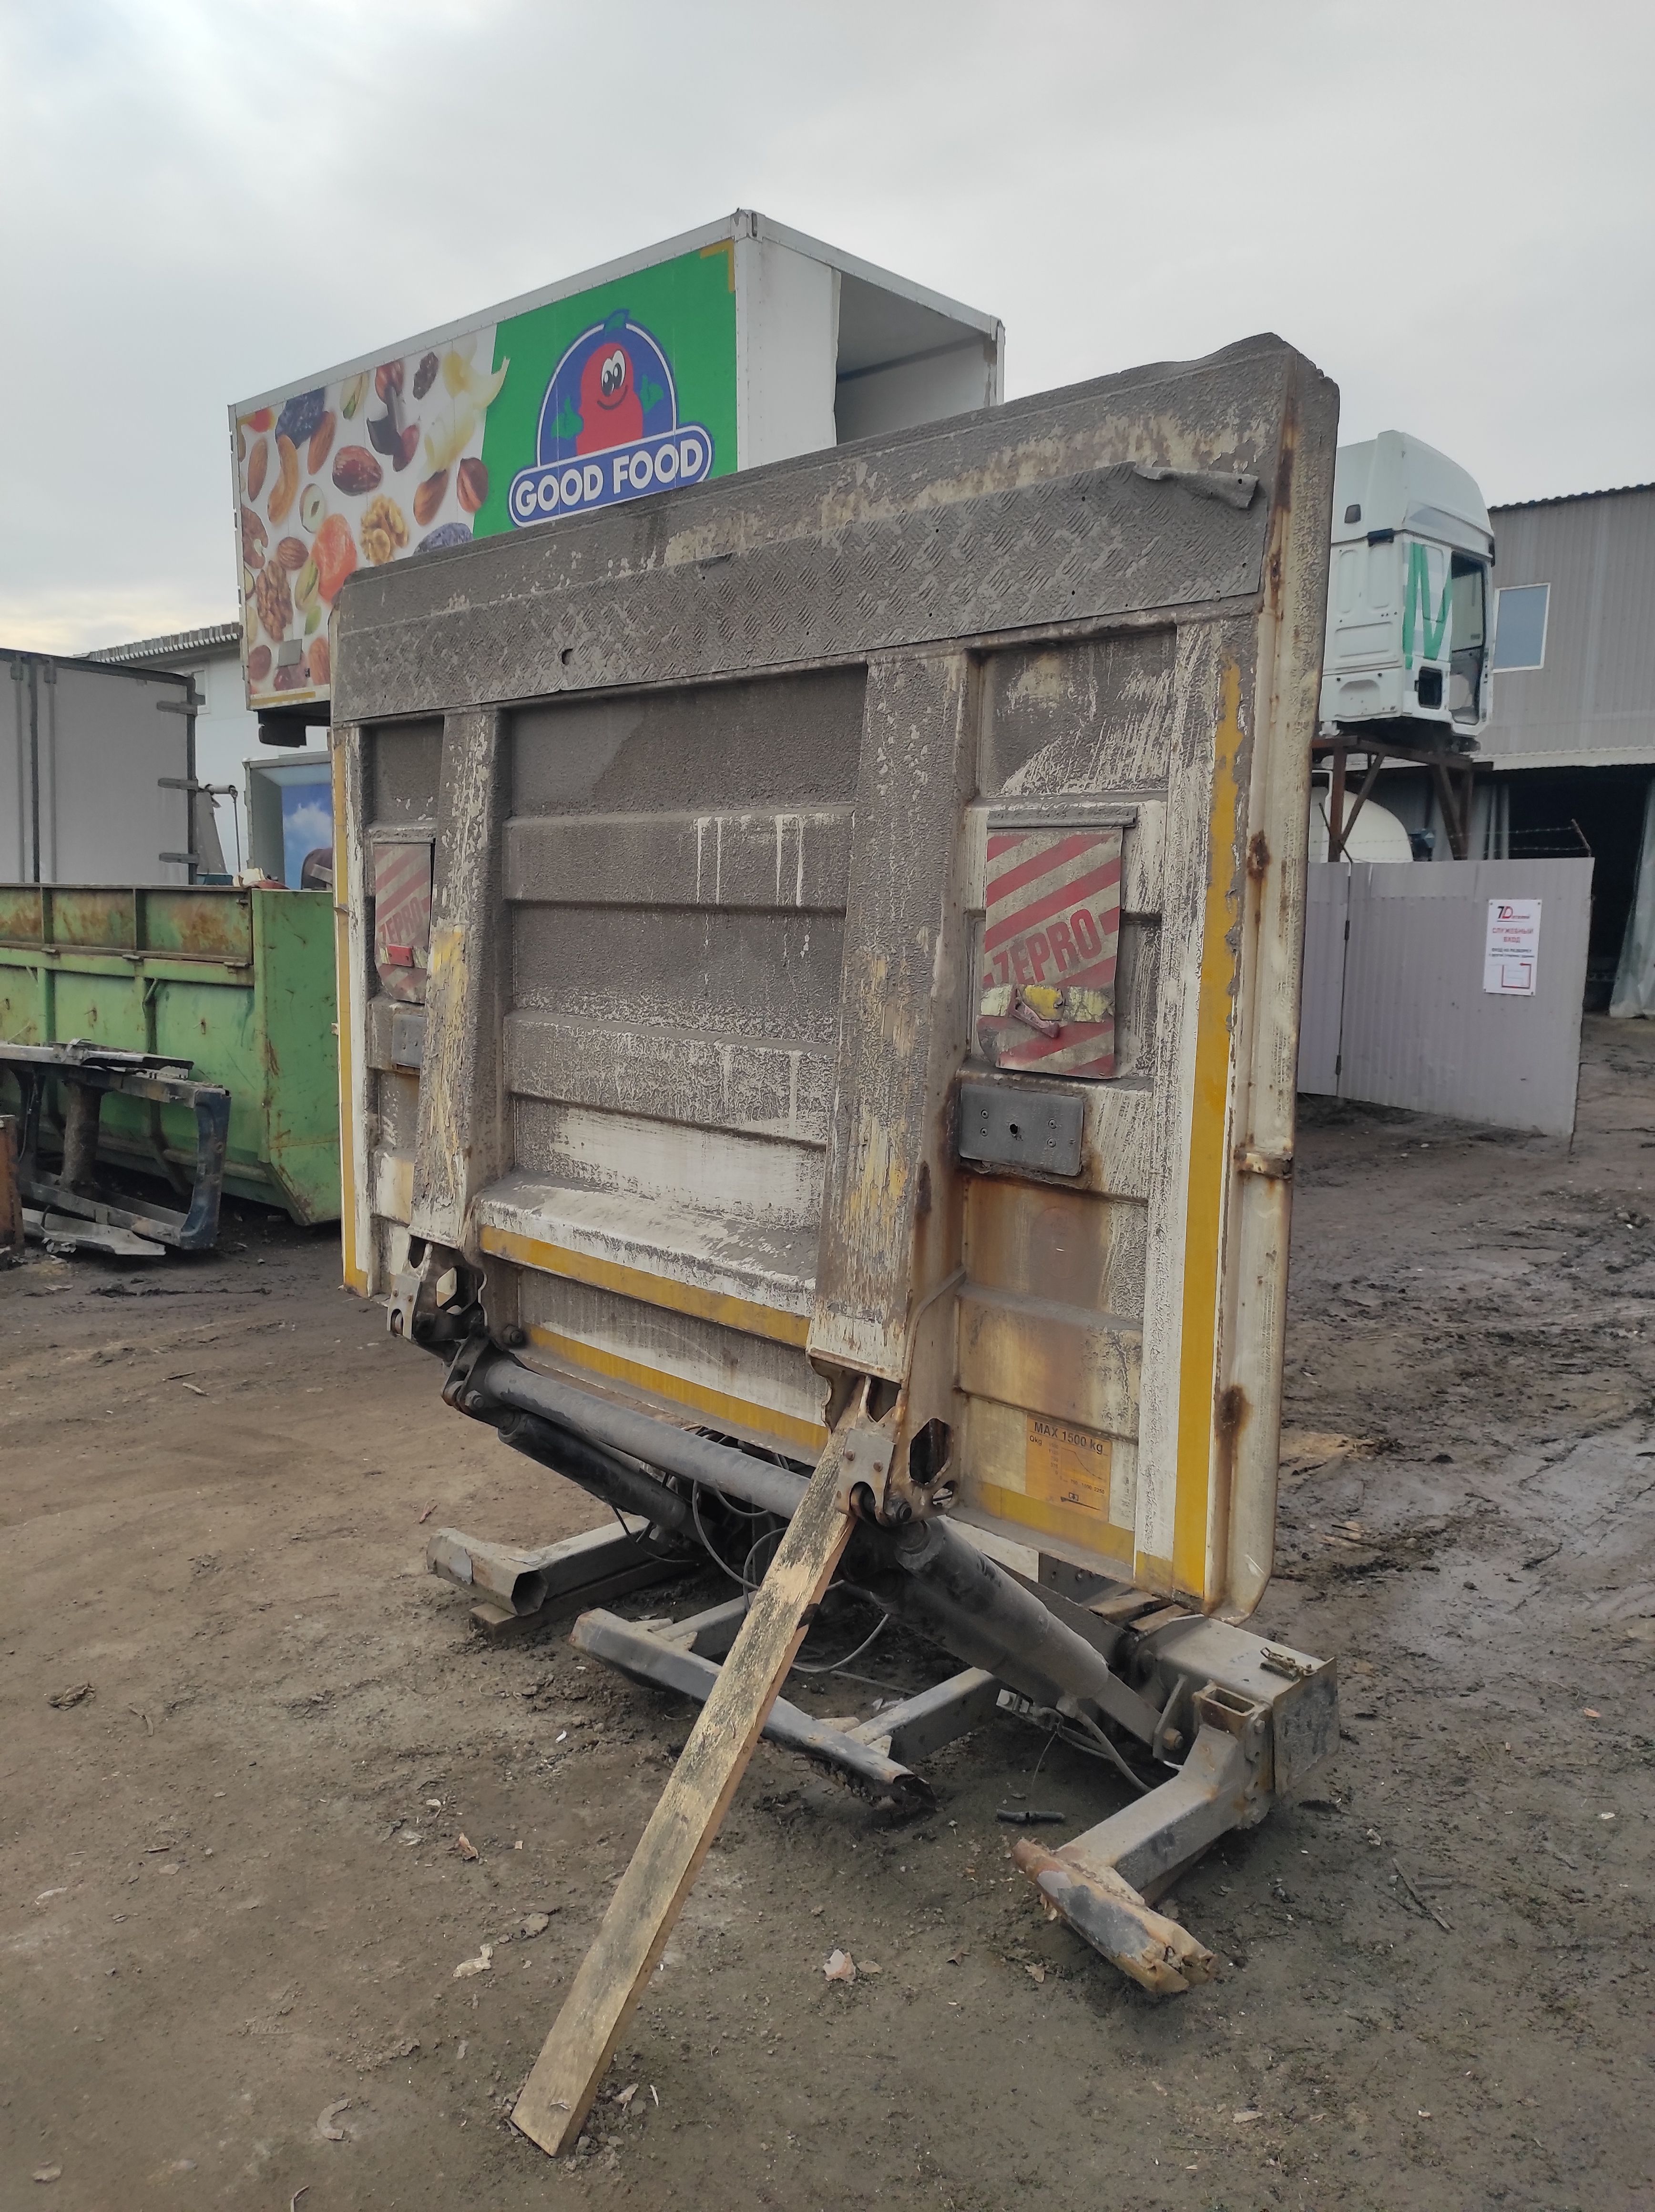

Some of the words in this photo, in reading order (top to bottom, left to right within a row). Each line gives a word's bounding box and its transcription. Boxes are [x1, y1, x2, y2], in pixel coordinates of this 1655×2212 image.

[515, 464, 603, 517] GOOD
[613, 439, 703, 494] FOOD
[378, 897, 424, 945] ZEPRO
[990, 908, 1102, 984] ZEPRO
[1029, 1435, 1042, 1446] Qkg
[1034, 1422, 1058, 1438] MAX
[1062, 1431, 1086, 1447] 1500
[1090, 1439, 1103, 1455] kg
